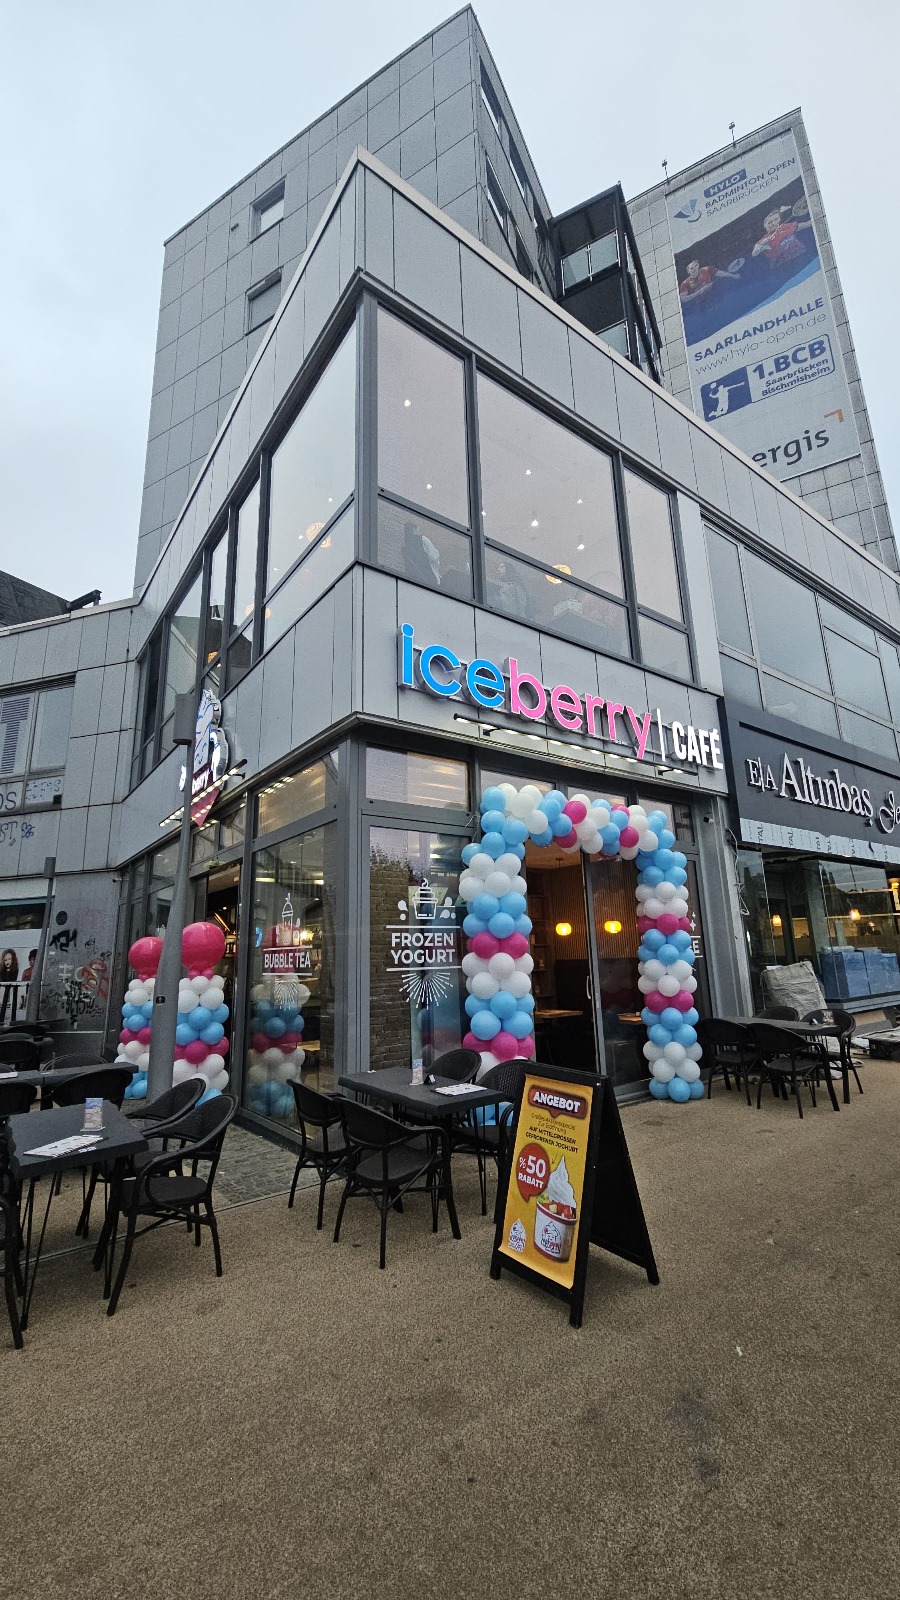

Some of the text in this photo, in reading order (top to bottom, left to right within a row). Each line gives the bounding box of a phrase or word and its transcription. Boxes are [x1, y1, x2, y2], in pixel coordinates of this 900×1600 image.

[705, 157, 796, 209] BADMINTON OPEN
[706, 175, 779, 217] SAARBRÜCKEN
[709, 173, 741, 195] HYLO
[694, 297, 825, 362] SAARLANDHALLE
[695, 313, 827, 375] www.hylo-open.de
[752, 340, 827, 380] 1.BCB
[765, 358, 829, 387] Saarbrücken
[761, 365, 831, 397] Bischmisheim
[401, 623, 724, 770] iceberry CAFÉ
[391, 933, 454, 947] FROZEN
[264, 951, 311, 968] BUBBLE TEA
[391, 949, 456, 964] YOGURT
[533, 1091, 580, 1113] ANGEBOT
[518, 1172, 544, 1189] RABATT
